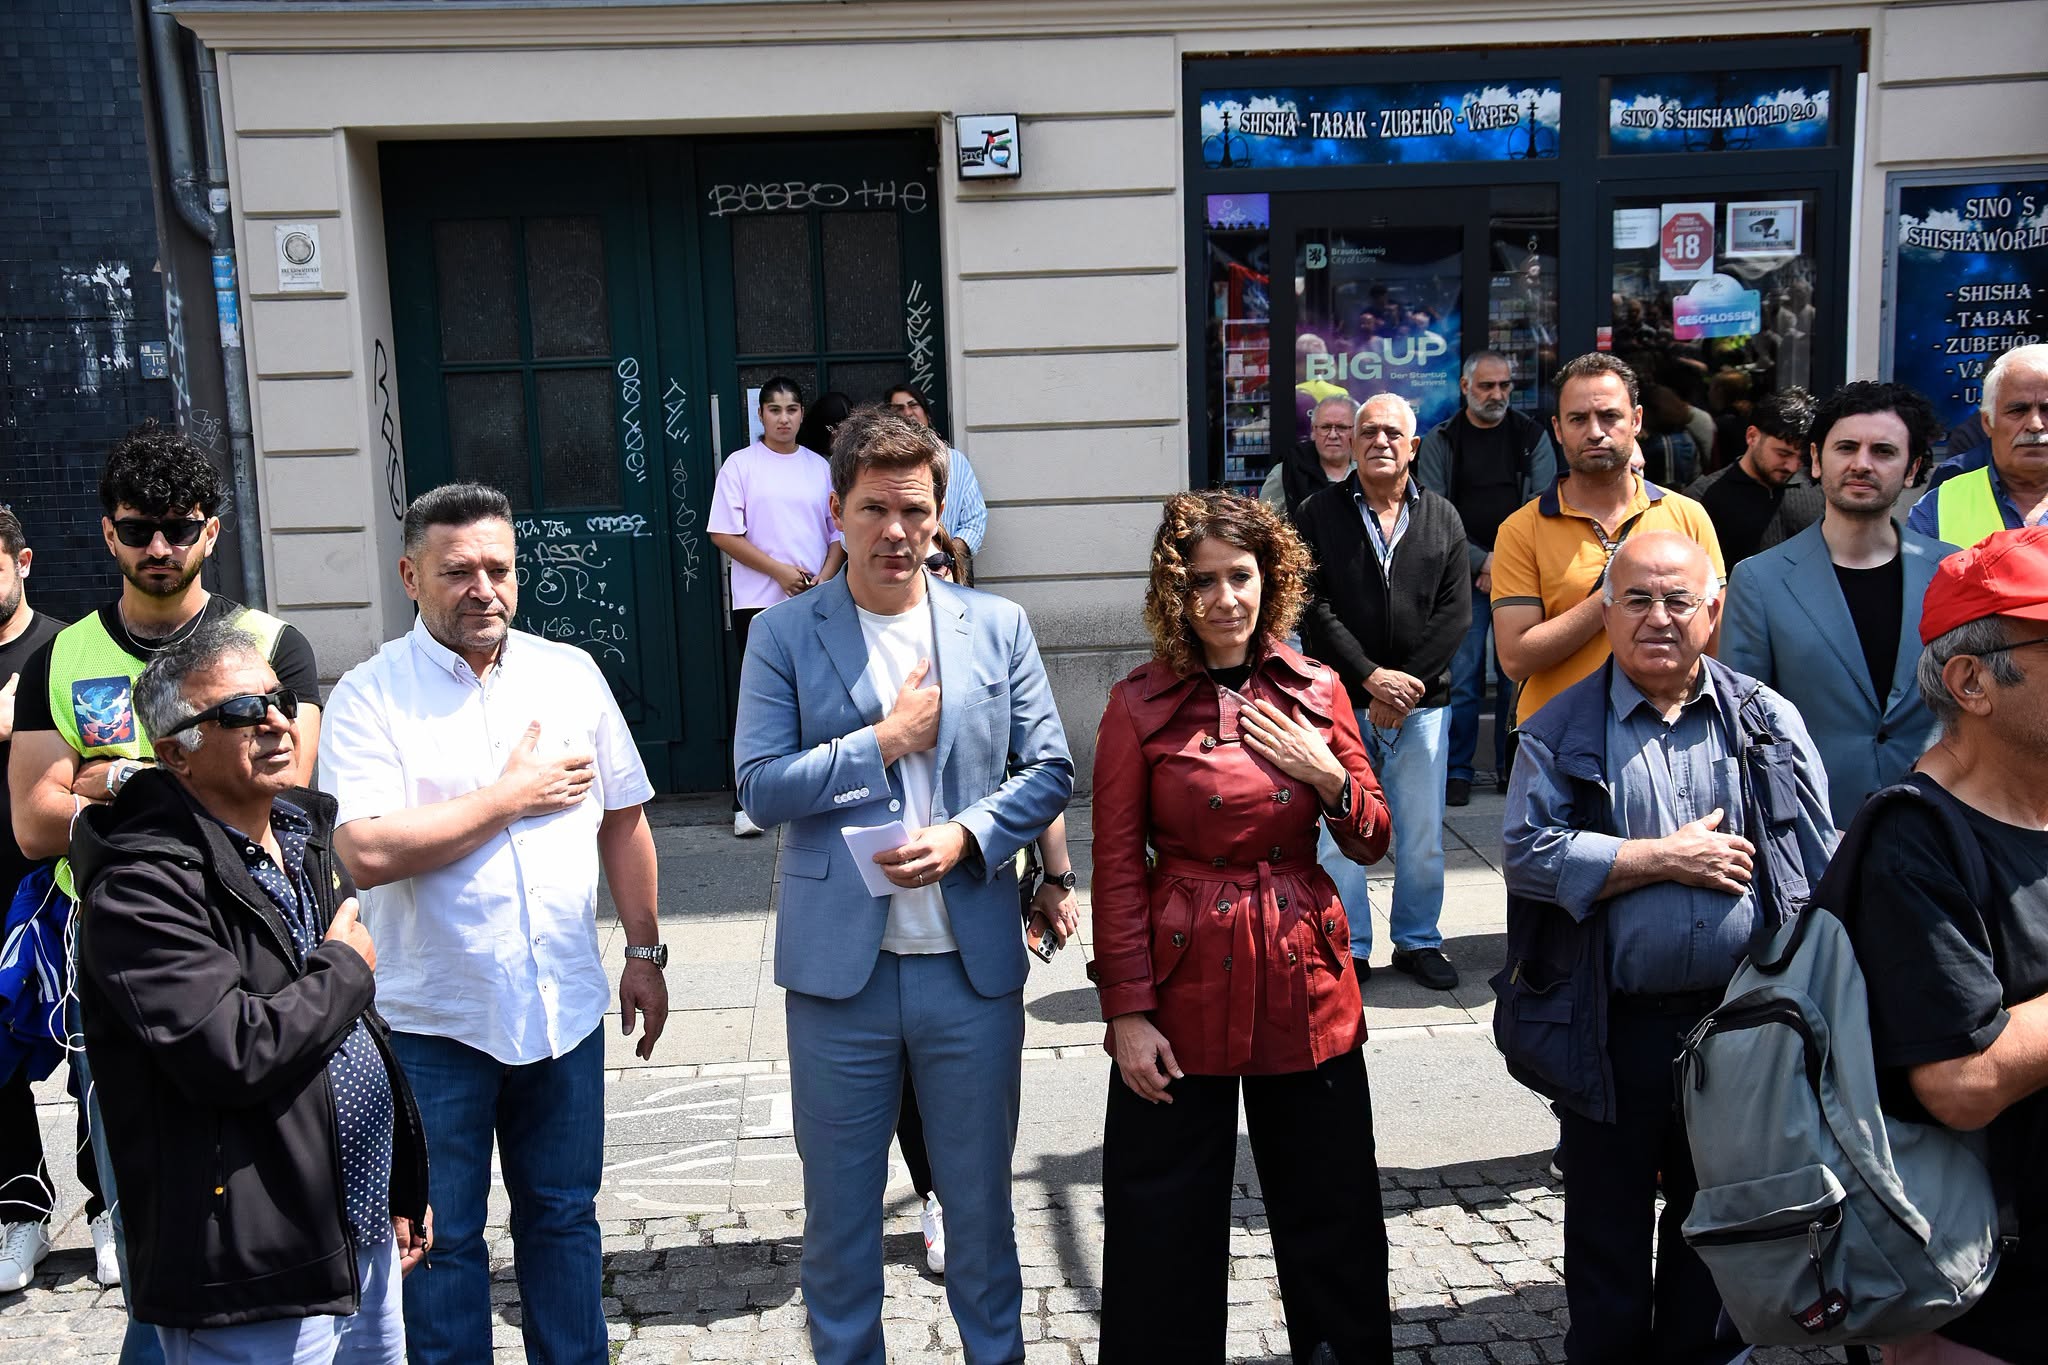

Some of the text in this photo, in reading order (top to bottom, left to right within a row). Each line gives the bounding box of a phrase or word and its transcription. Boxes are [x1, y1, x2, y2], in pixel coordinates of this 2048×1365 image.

[1239, 111, 1298, 137] SHISHA
[1310, 111, 1368, 138] TABAK
[1380, 102, 1454, 137] ZUBEHÖR
[1465, 103, 1519, 131] VAPES
[1621, 110, 1657, 127] SINO
[1677, 104, 1788, 128] SHISHAWORLD
[1791, 103, 1817, 121] 2.0
[1965, 198, 2012, 219] SINO
[1673, 234, 1700, 259] 18
[1958, 284, 2032, 302] SHISHA
[1677, 311, 1758, 326] GESCHLOSSEN
[1957, 309, 2032, 328] TABAK
[1306, 331, 1447, 380] BIG UP
[1409, 371, 1447, 381] Startup
[1803, 1302, 1841, 1328] EASTAK
